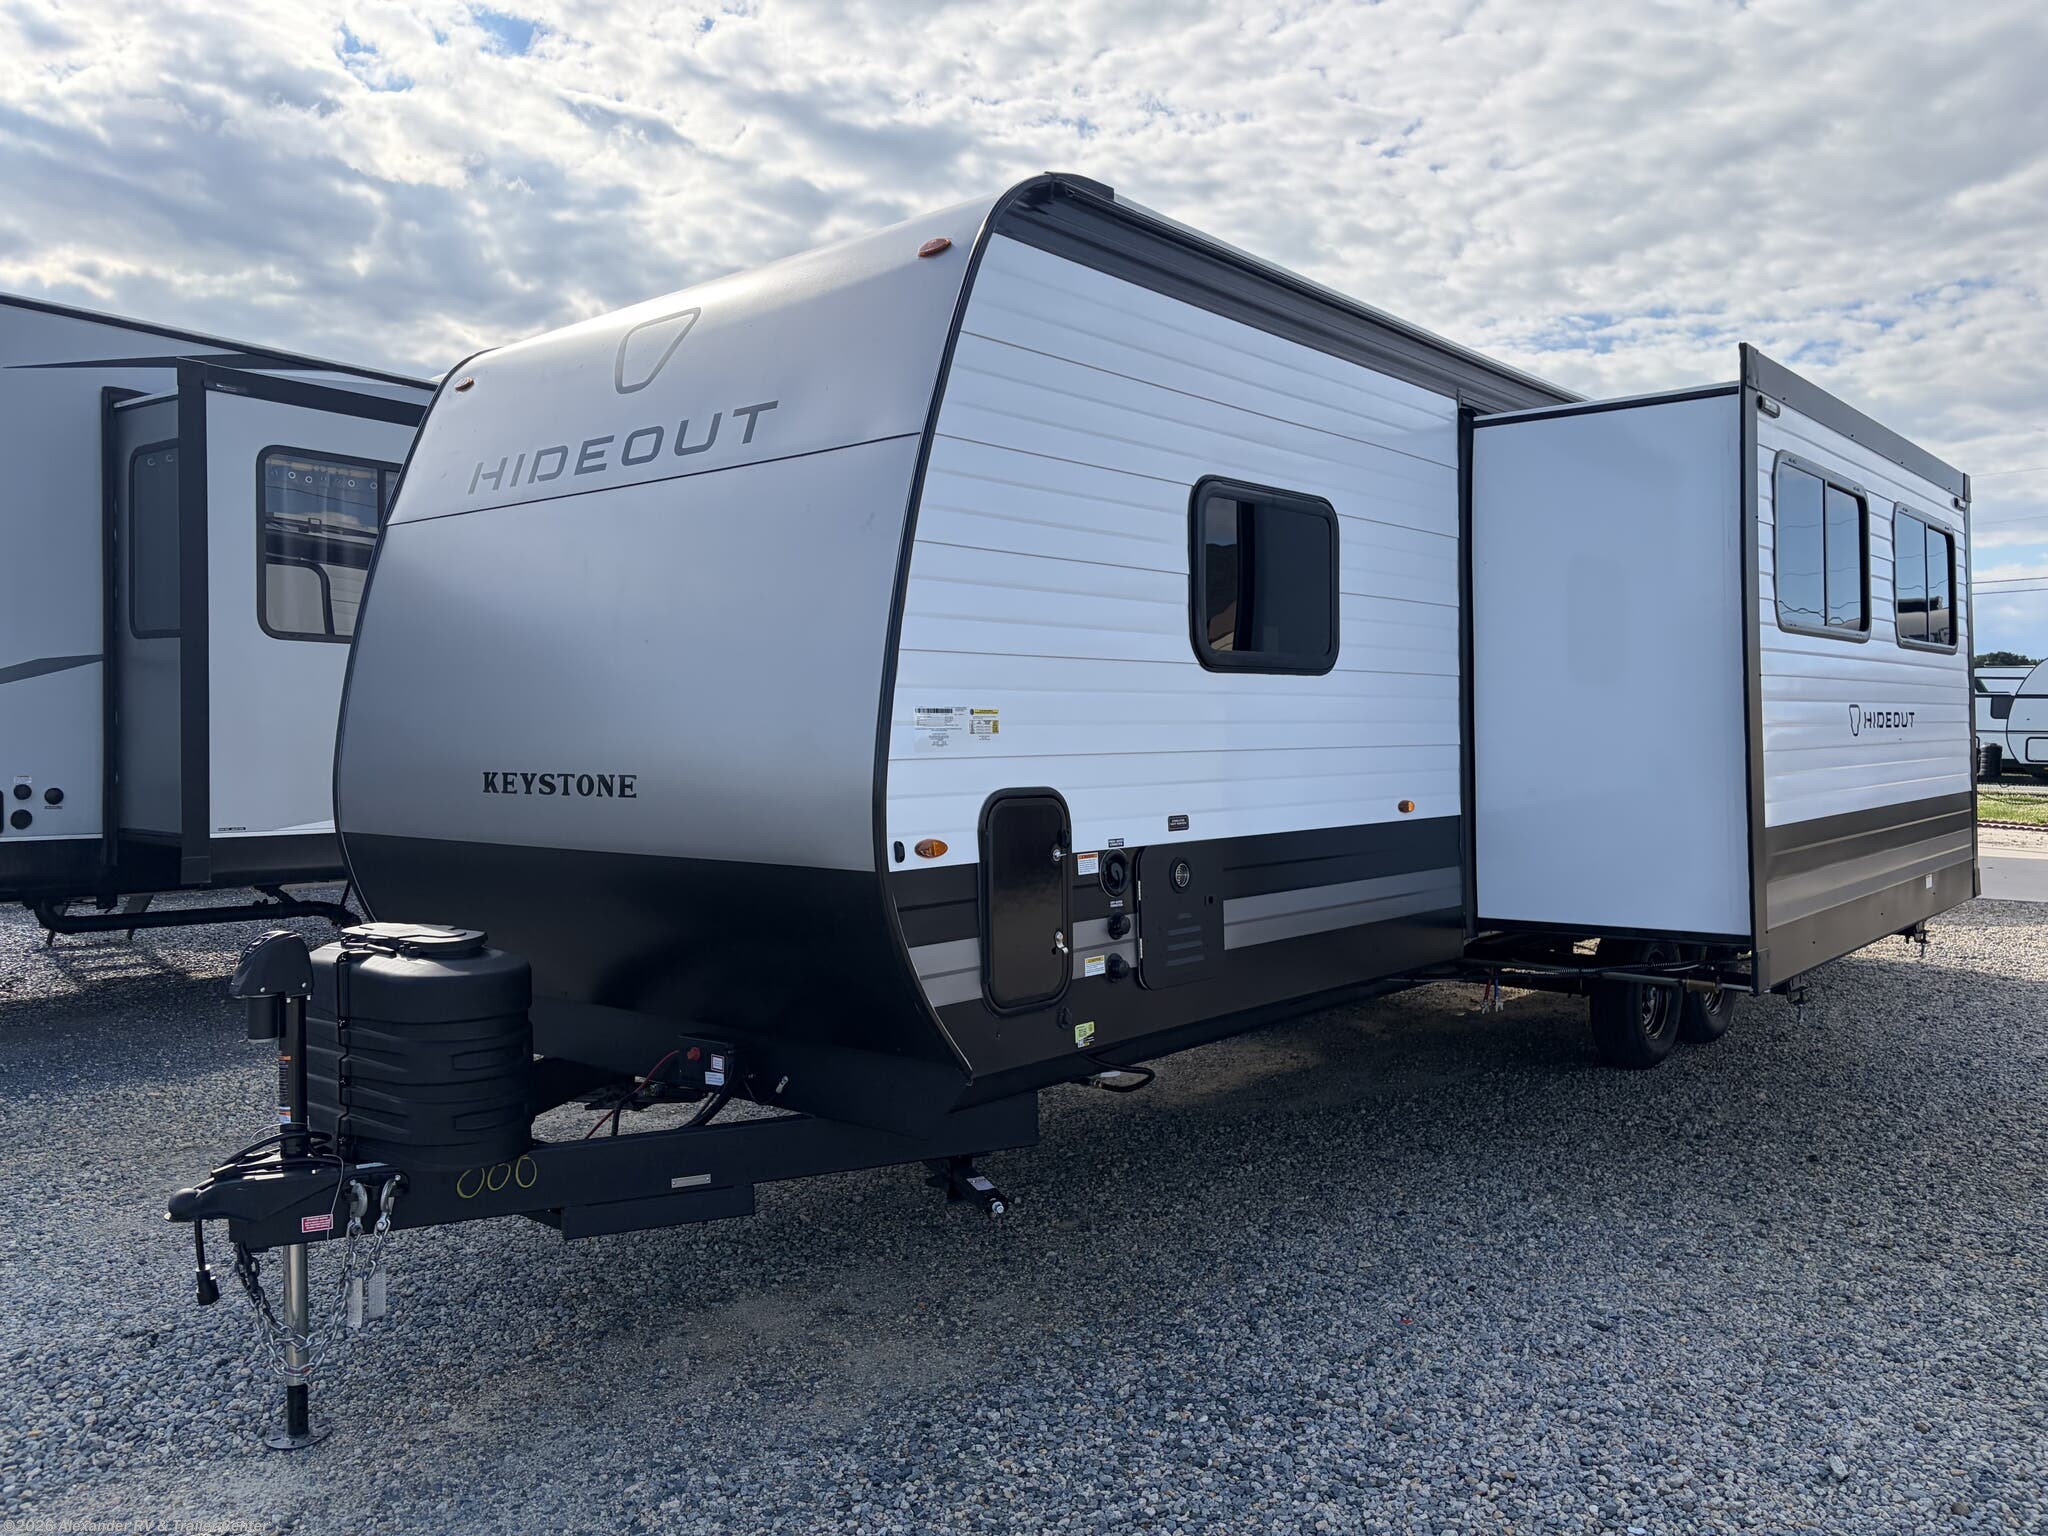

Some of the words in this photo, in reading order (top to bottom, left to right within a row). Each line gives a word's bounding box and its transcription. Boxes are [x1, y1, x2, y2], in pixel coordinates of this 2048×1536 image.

[467, 400, 780, 495] HIDEOUT
[1863, 711, 1915, 729] HIDEOUT
[482, 771, 637, 799] KEYSTONE
